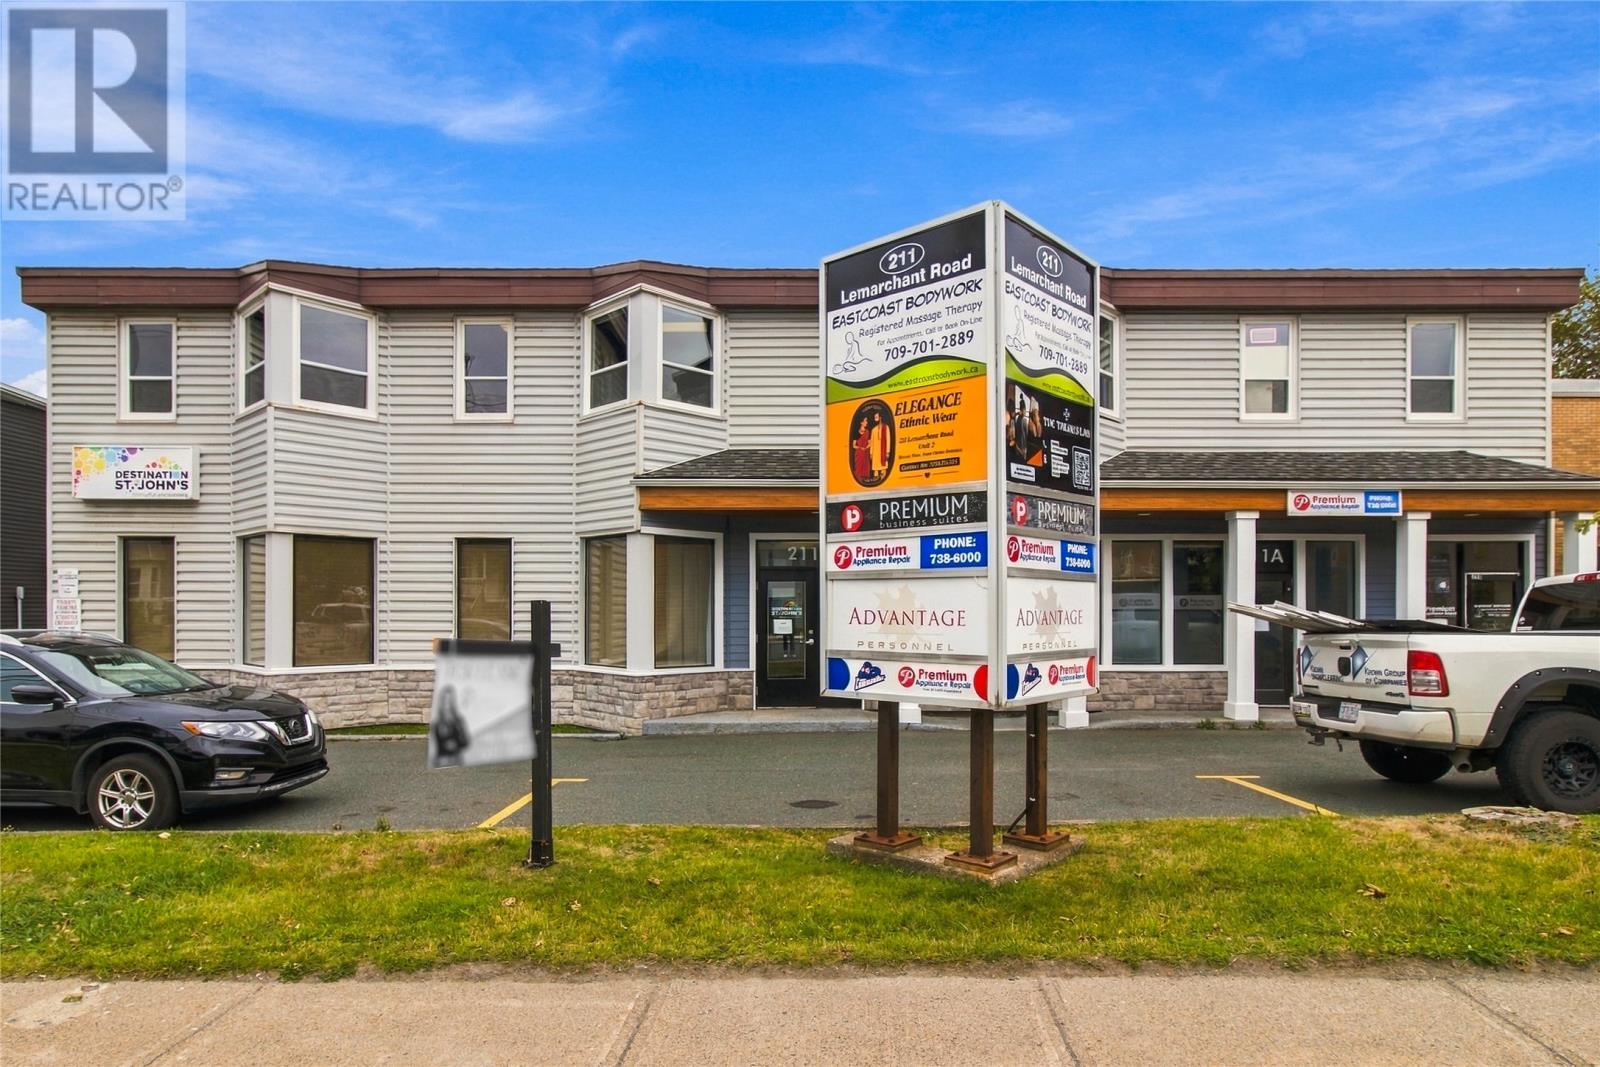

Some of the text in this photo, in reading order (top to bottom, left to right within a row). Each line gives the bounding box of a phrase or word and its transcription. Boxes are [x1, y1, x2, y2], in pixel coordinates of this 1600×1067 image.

[888, 248, 916, 270] 211
[1042, 251, 1058, 273] 211
[841, 253, 972, 305] Lemarchant Road
[1011, 256, 1087, 308] Lemarchant Road
[832, 278, 983, 330] EASTCOAST BODYWORK
[1005, 280, 1091, 333] EASTCOAST BODYWORK
[859, 301, 983, 338] Registered Massage Therapy
[884, 329, 974, 361] 709-701-2889
[894, 392, 963, 417] ELEGANCE
[899, 412, 958, 429] Ethnic Wear
[138, 480, 189, 490] JOHN'S
[879, 494, 968, 521] PREMIUM
[1312, 495, 1356, 504] Premium
[1038, 500, 1086, 525] PREMIUM
[879, 514, 969, 529] business suites
[855, 544, 907, 558] Premium
[933, 536, 977, 550] PHONE:
[1021, 539, 1054, 556] Premium
[788, 546, 817, 561] 211
[853, 555, 911, 568] Appliance Repair
[930, 552, 981, 565] 738-6000
[848, 607, 966, 627] ADVANTAGE
[1016, 608, 1083, 627] ADVANTAGE
[857, 640, 954, 651] PERSONNEL
[1022, 640, 1078, 651] PERSONNEL
[918, 668, 967, 682] Premium
[949, 681, 971, 690] Repair
